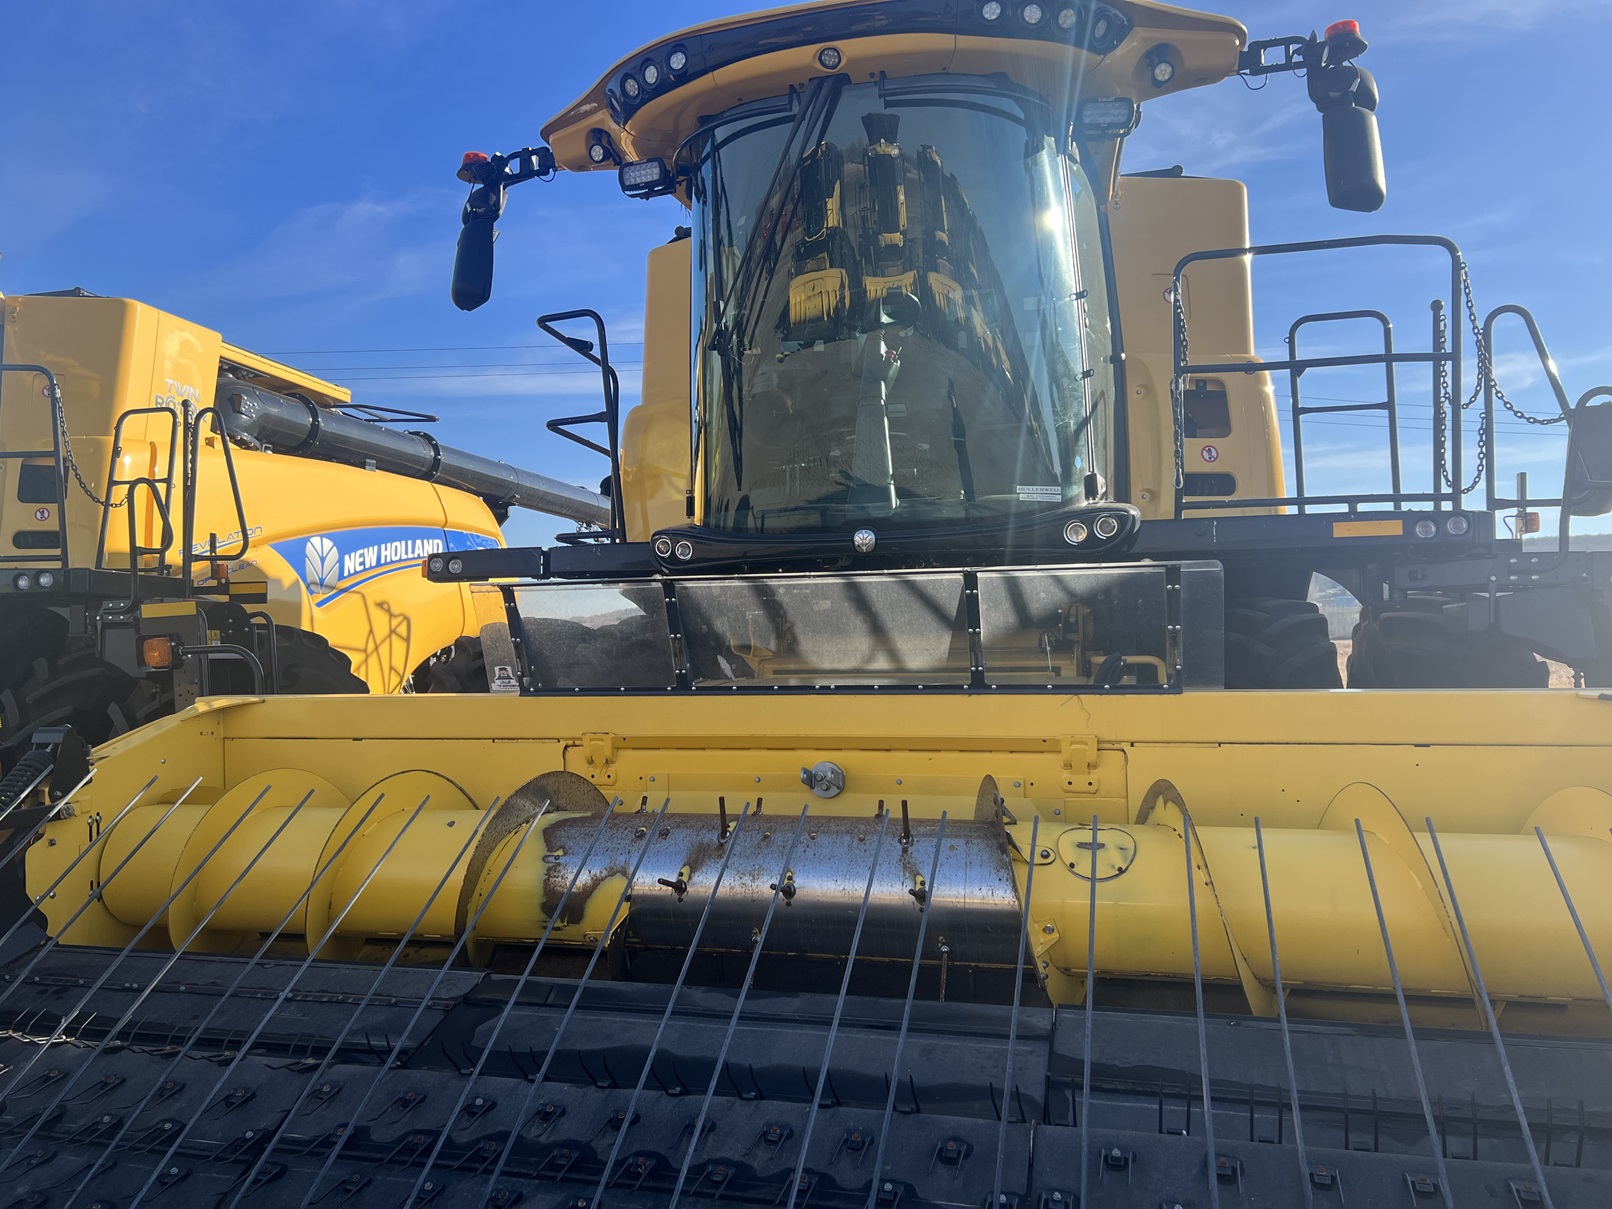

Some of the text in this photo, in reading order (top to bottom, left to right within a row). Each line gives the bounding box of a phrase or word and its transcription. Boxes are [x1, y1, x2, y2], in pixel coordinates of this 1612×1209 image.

[165, 378, 200, 402] TWIN
[344, 539, 443, 576] NEW HOLLAND
